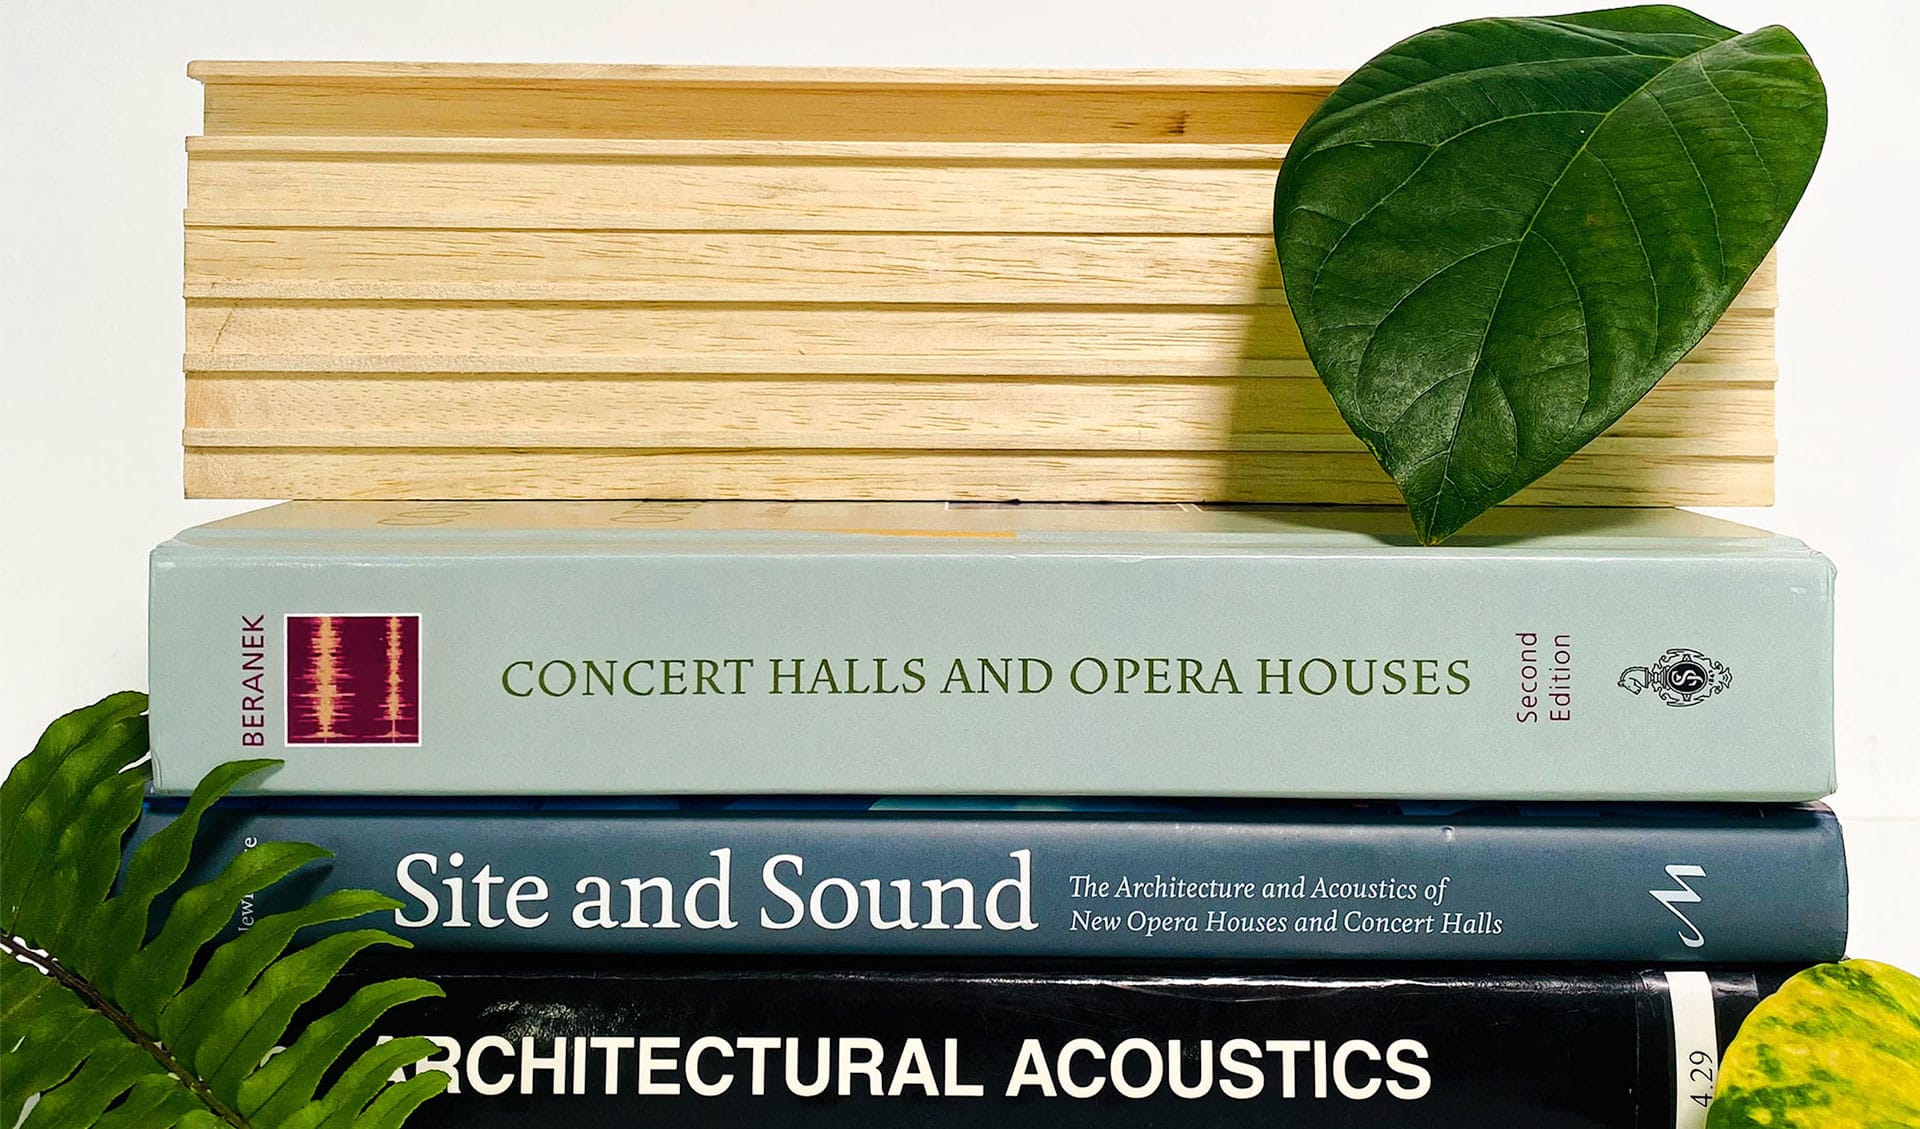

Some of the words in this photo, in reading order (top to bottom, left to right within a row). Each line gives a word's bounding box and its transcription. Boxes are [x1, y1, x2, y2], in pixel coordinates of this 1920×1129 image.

[241, 614, 265, 747] BERANEK
[501, 658, 755, 698] CONCERT
[768, 657, 926, 695] HALLS
[939, 657, 1053, 694] AND
[1069, 656, 1244, 695] OPERA
[1256, 657, 1471, 696] HOUSES
[1515, 632, 1538, 724] Second
[1549, 634, 1571, 721] Edition
[394, 852, 549, 928] Site
[572, 847, 739, 929] and
[760, 848, 1040, 931] Sound
[1069, 875, 1110, 899] The
[1114, 875, 1256, 899] Architecture
[1261, 875, 1305, 900] and
[1310, 876, 1418, 900] Acoustics
[1424, 876, 1448, 907] of
[1069, 910, 1122, 932] New
[1127, 910, 1199, 937] Opera
[1204, 910, 1288, 933] Houses
[1294, 908, 1338, 933] and
[1344, 910, 1435, 934] Concert
[1440, 911, 1503, 935] Halls
[375, 1036, 985, 1098] RCHITECTURAL
[1005, 1037, 1432, 1100] ACOUSTICS
[1689, 1050, 1713, 1108] 4.29
